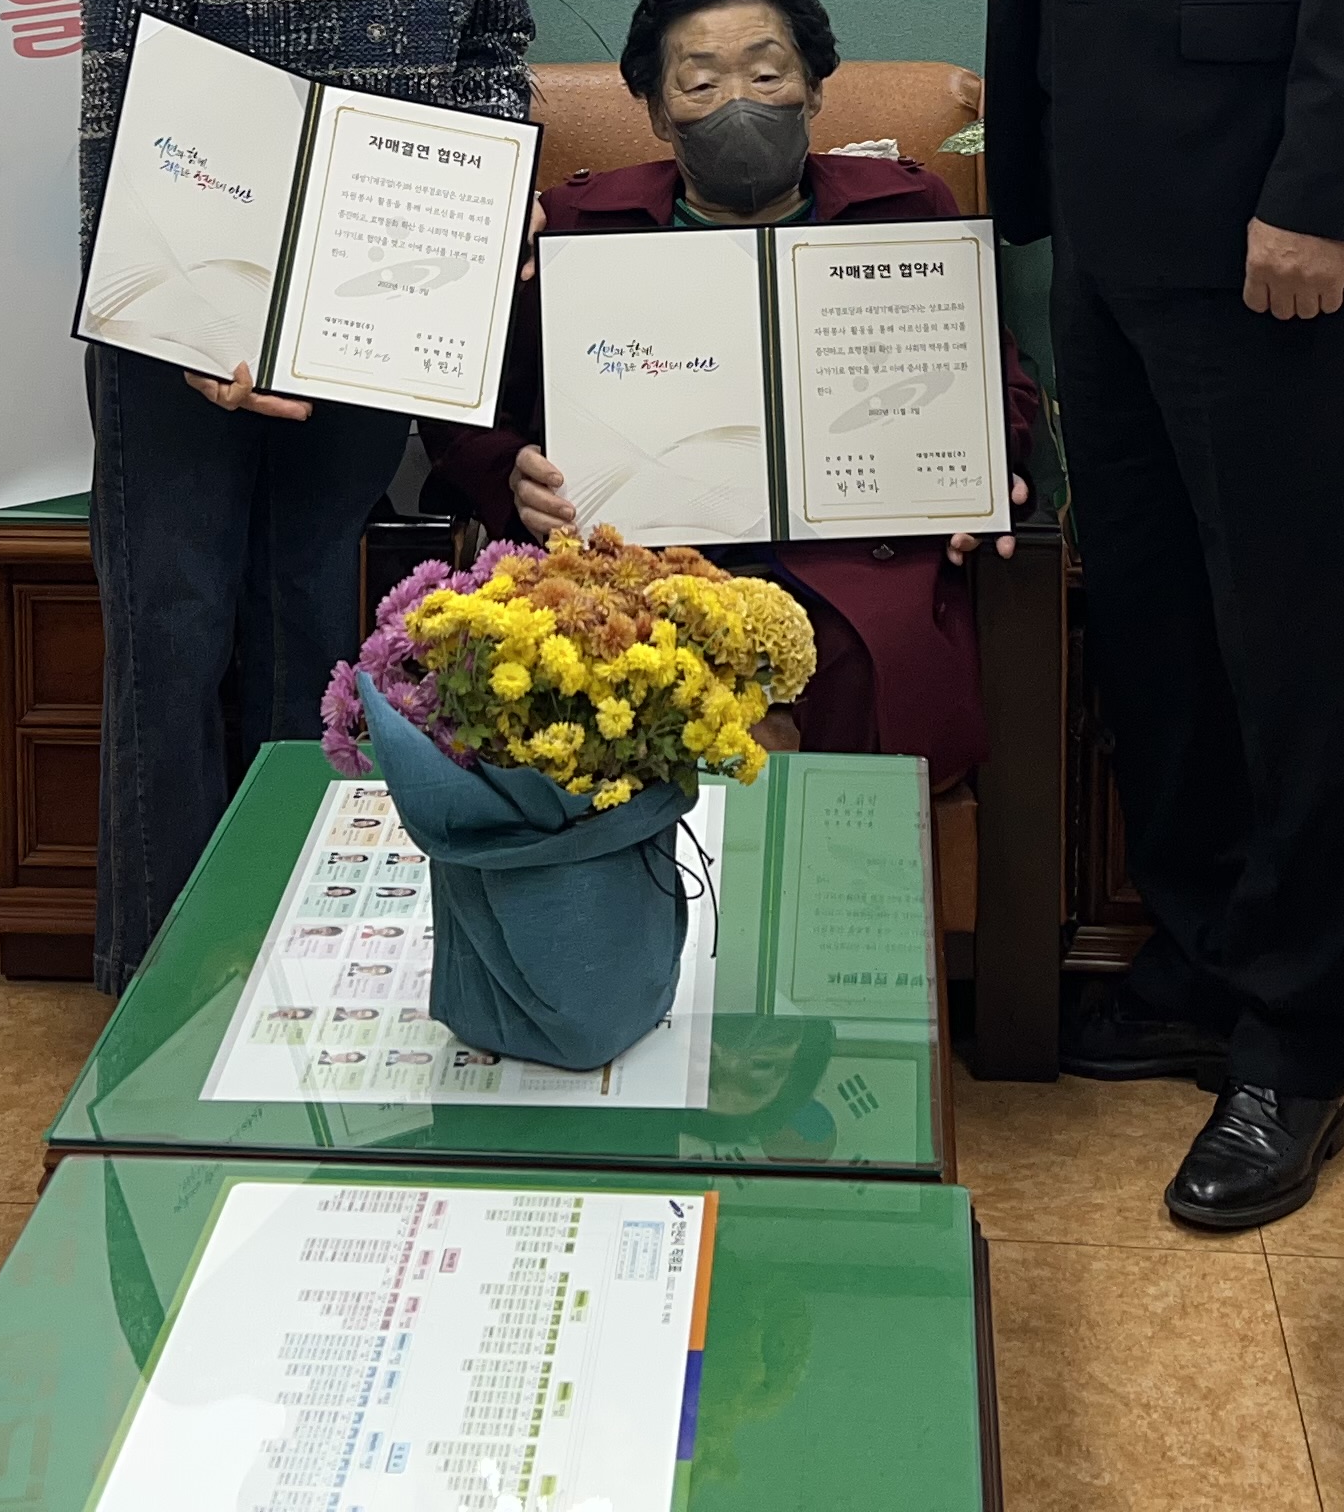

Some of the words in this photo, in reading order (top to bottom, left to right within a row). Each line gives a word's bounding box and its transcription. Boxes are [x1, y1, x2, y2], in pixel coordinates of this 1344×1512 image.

[368, 135, 431, 161] 자매결연
[437, 146, 483, 170] 협약서
[829, 263, 892, 280] 자매결연
[898, 261, 945, 278] 협약서
[686, 357, 720, 373] 안산
